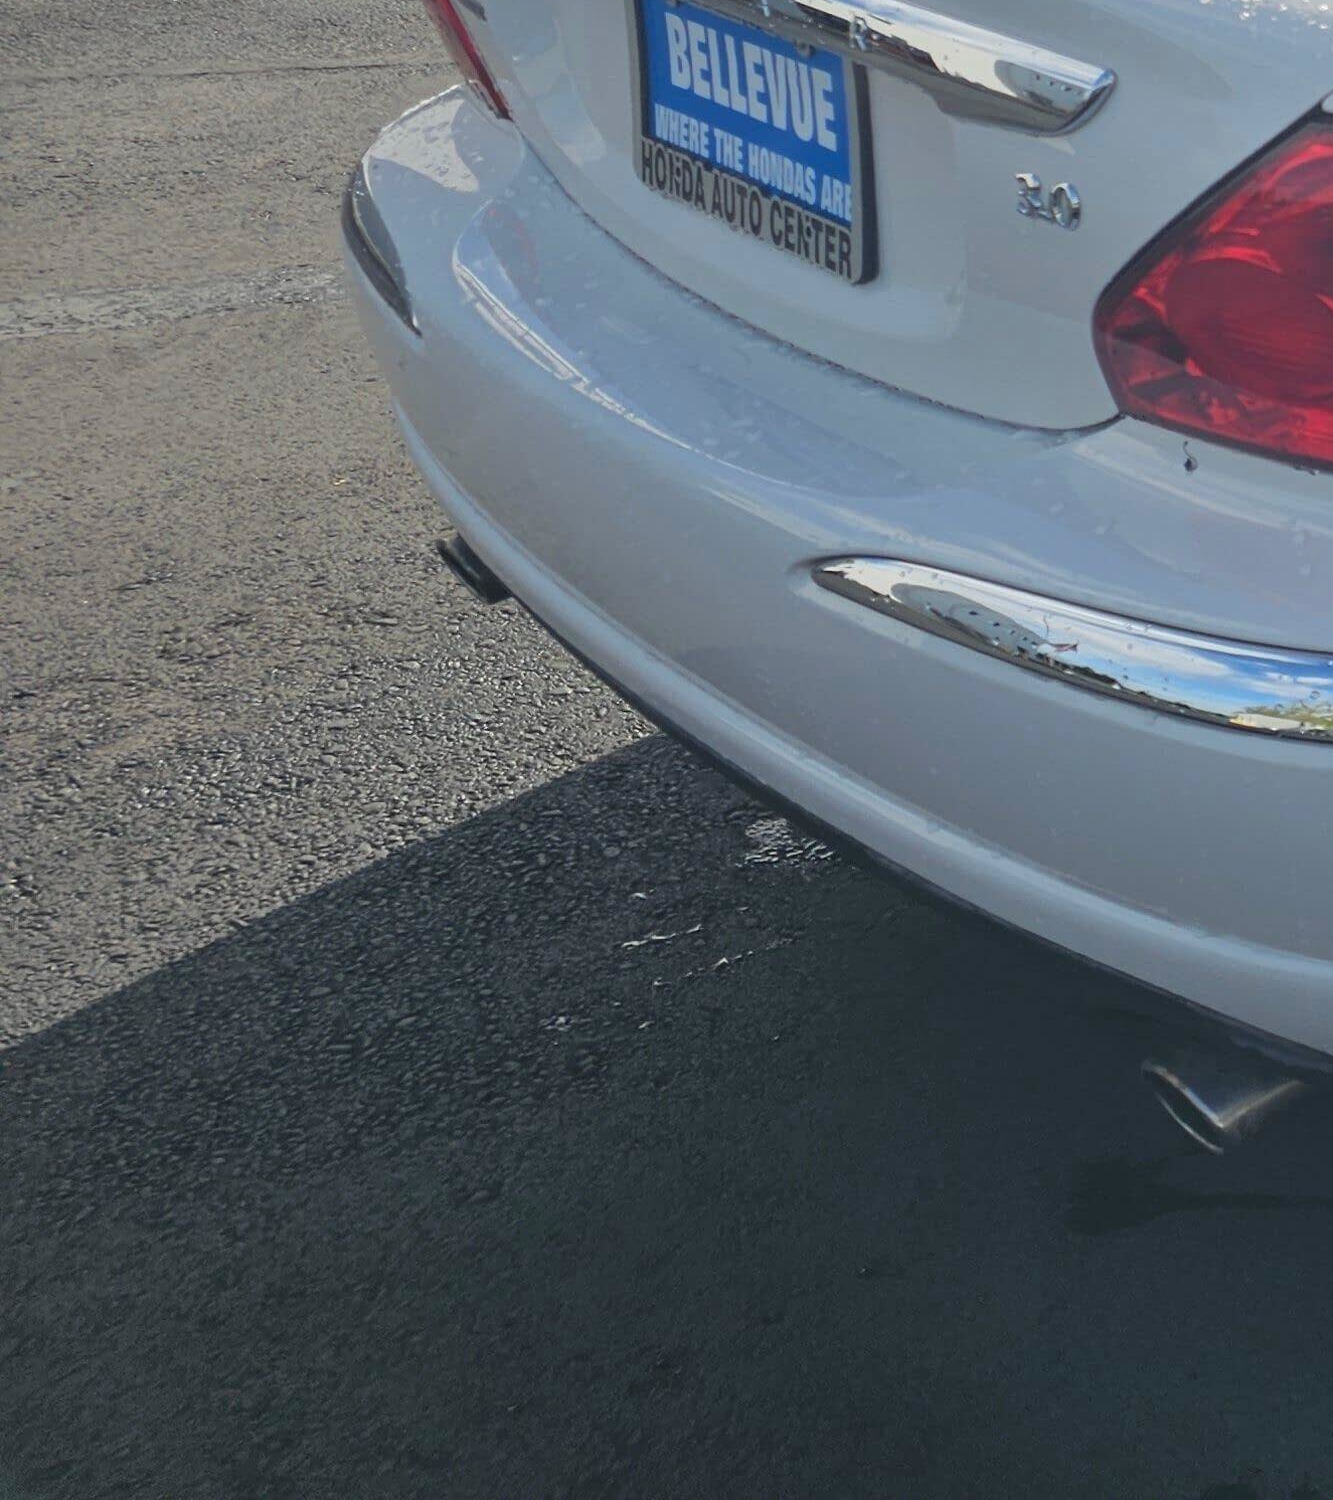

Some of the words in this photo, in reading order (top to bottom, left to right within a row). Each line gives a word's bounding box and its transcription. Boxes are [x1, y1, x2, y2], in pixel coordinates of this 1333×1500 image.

[665, 11, 838, 152] BELLEVUE
[641, 137, 706, 213] HONDA
[711, 169, 762, 238] AUTO
[769, 197, 853, 282] CENTER
[655, 102, 710, 158] WHERE
[714, 127, 743, 173] THE
[748, 142, 816, 205] HONDAS
[820, 174, 853, 222] ARE
